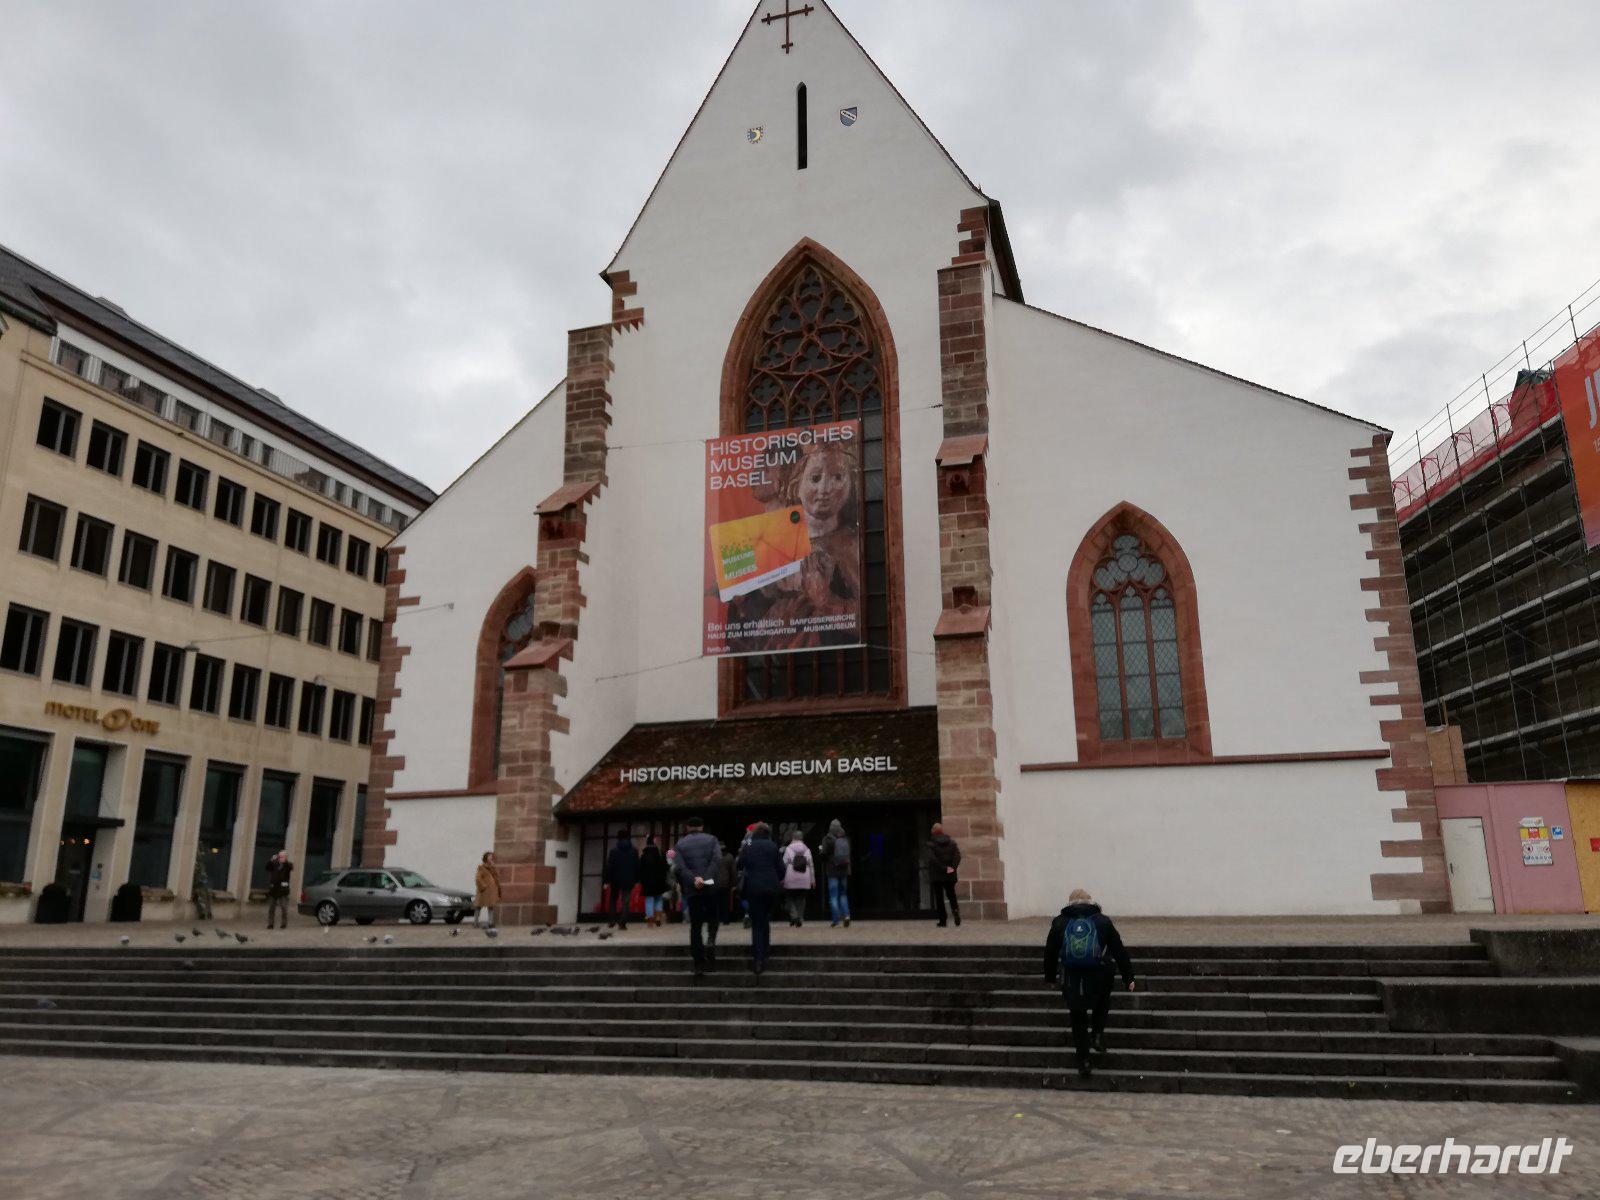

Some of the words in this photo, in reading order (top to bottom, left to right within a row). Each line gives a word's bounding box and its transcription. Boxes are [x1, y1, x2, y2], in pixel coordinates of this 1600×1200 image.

[710, 425, 853, 456] HISTORISCHES
[710, 450, 797, 474] MUSEUM
[710, 471, 772, 490] BASEL
[707, 622, 722, 631] Bei
[725, 622, 741, 630] uns
[743, 618, 784, 628] erhältlich
[707, 631, 726, 639] HAUS
[727, 630, 743, 639] ZUM
[743, 627, 796, 637] KIRSCHGARTEN
[619, 763, 745, 783] HISTORISCHES
[751, 759, 831, 777] MUSEUM
[837, 756, 898, 773] BASEL
